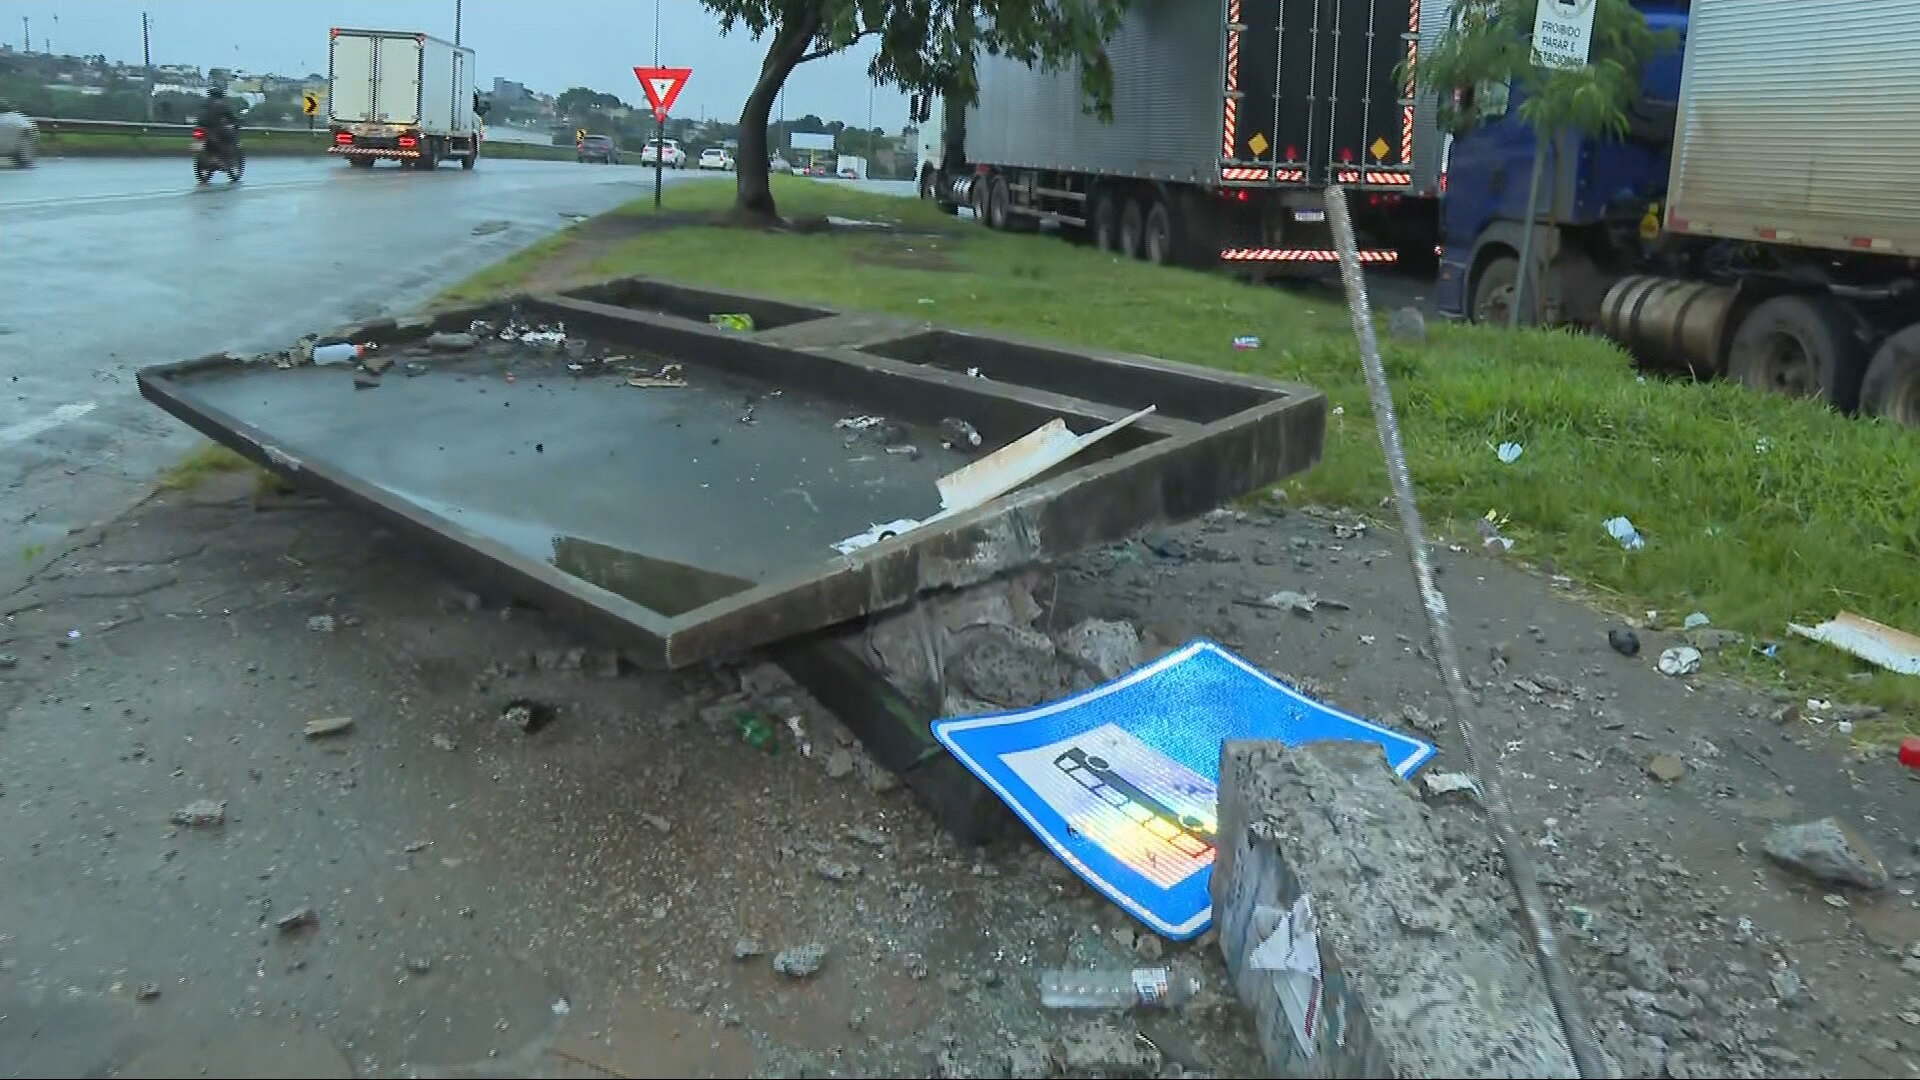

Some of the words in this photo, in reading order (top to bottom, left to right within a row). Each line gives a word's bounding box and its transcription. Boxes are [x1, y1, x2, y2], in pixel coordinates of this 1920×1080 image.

[1542, 21, 1581, 38] PROIBIDO
[1542, 36, 1569, 50] PARAR
[1534, 49, 1584, 66] STACIOAR
